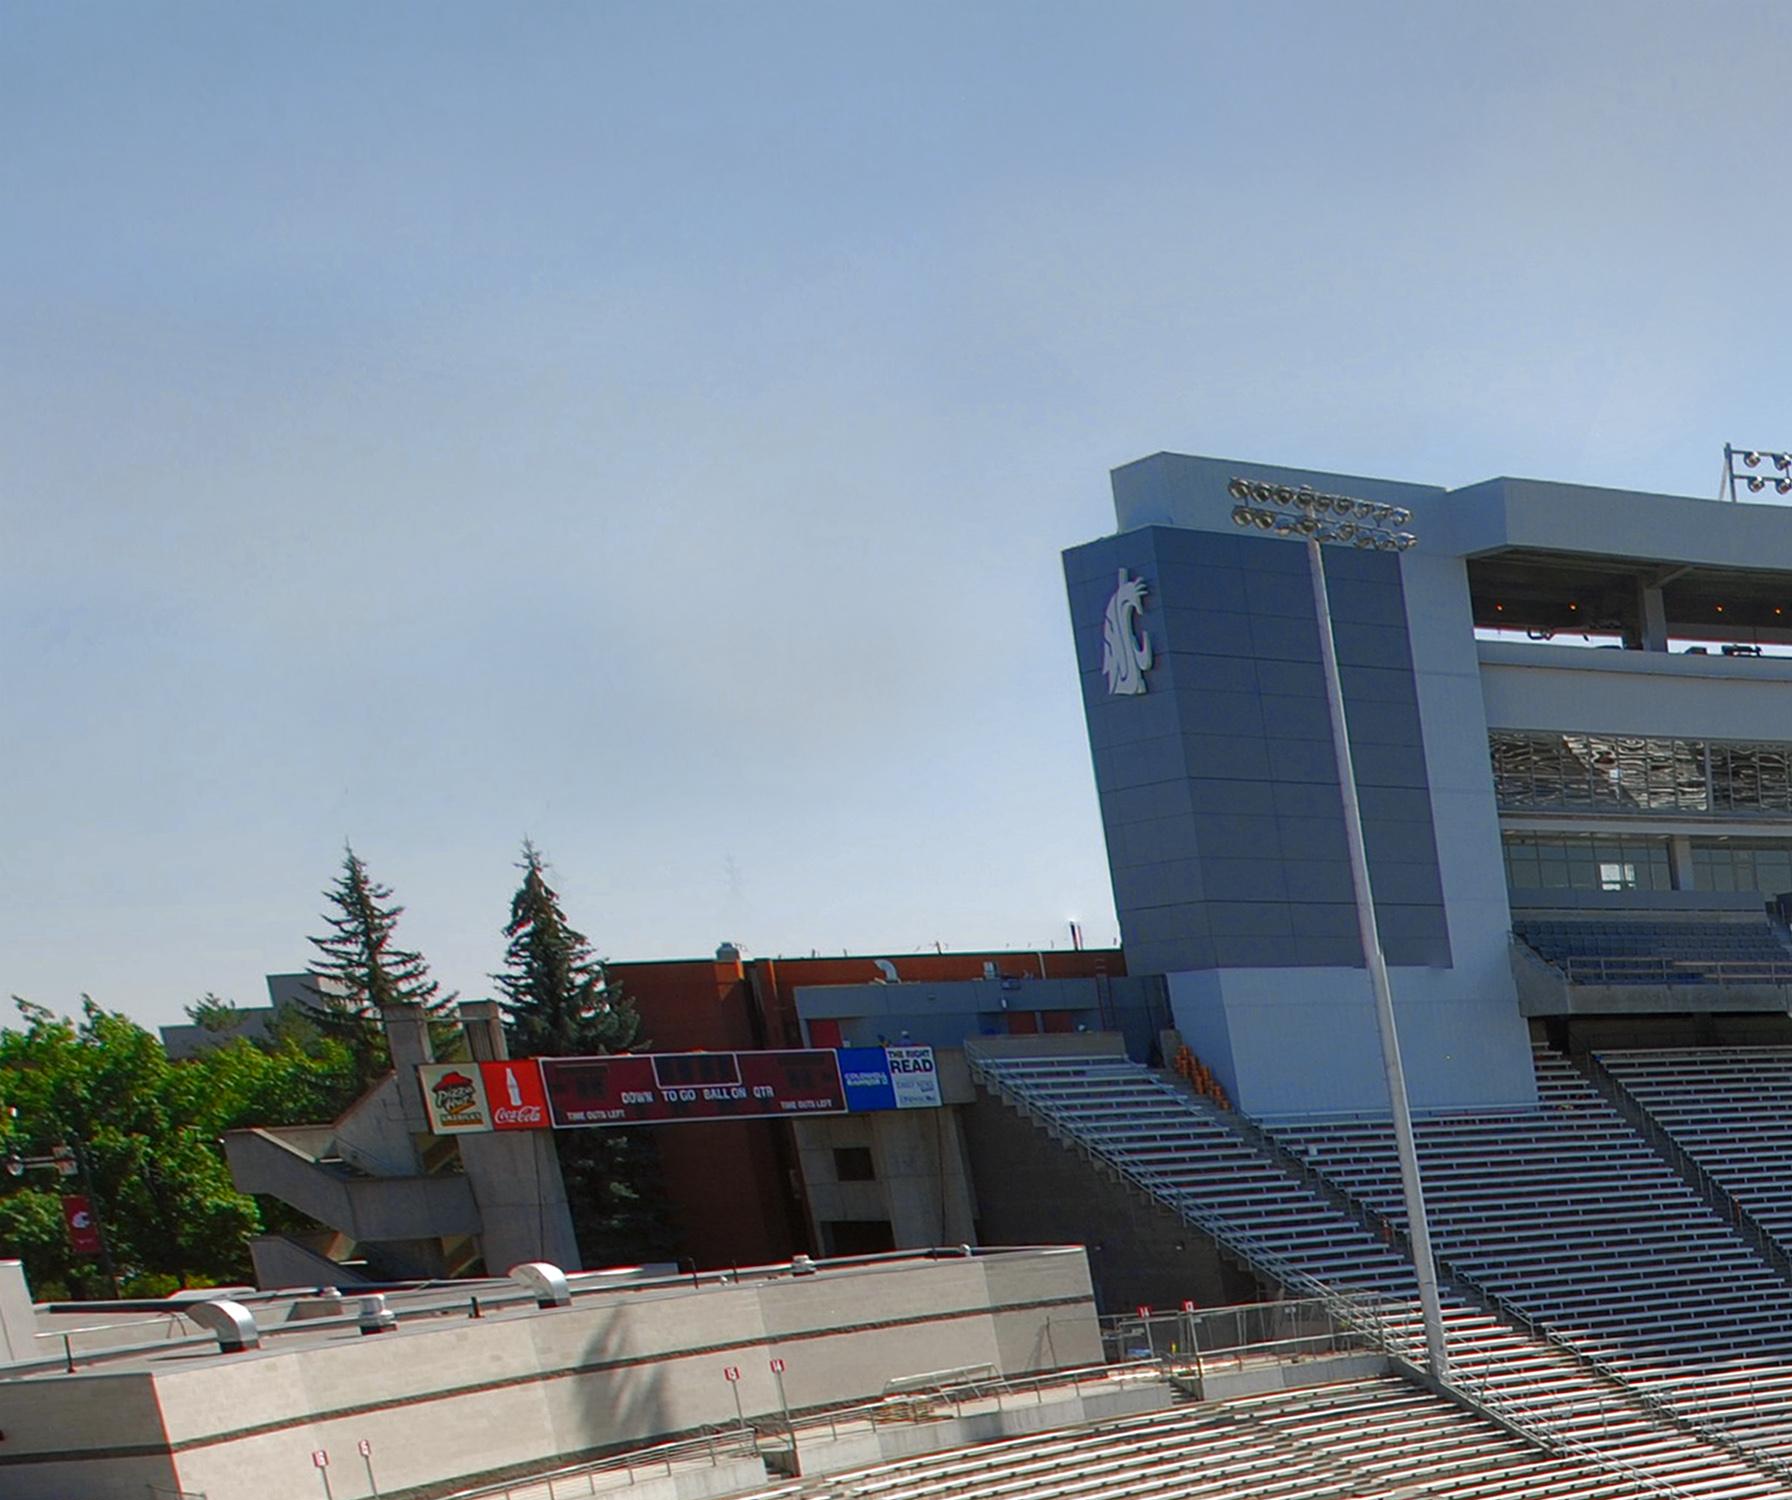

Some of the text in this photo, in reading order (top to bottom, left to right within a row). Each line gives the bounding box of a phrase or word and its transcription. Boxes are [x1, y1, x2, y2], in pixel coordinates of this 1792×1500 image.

[888, 1050, 903, 1059] THE
[890, 1058, 934, 1073] READ
[621, 1090, 697, 1104] DOWN TO GO
[703, 1087, 747, 1101] BALL ON
[753, 1086, 774, 1098] QTR
[495, 1106, 542, 1124] Coca-Cola
